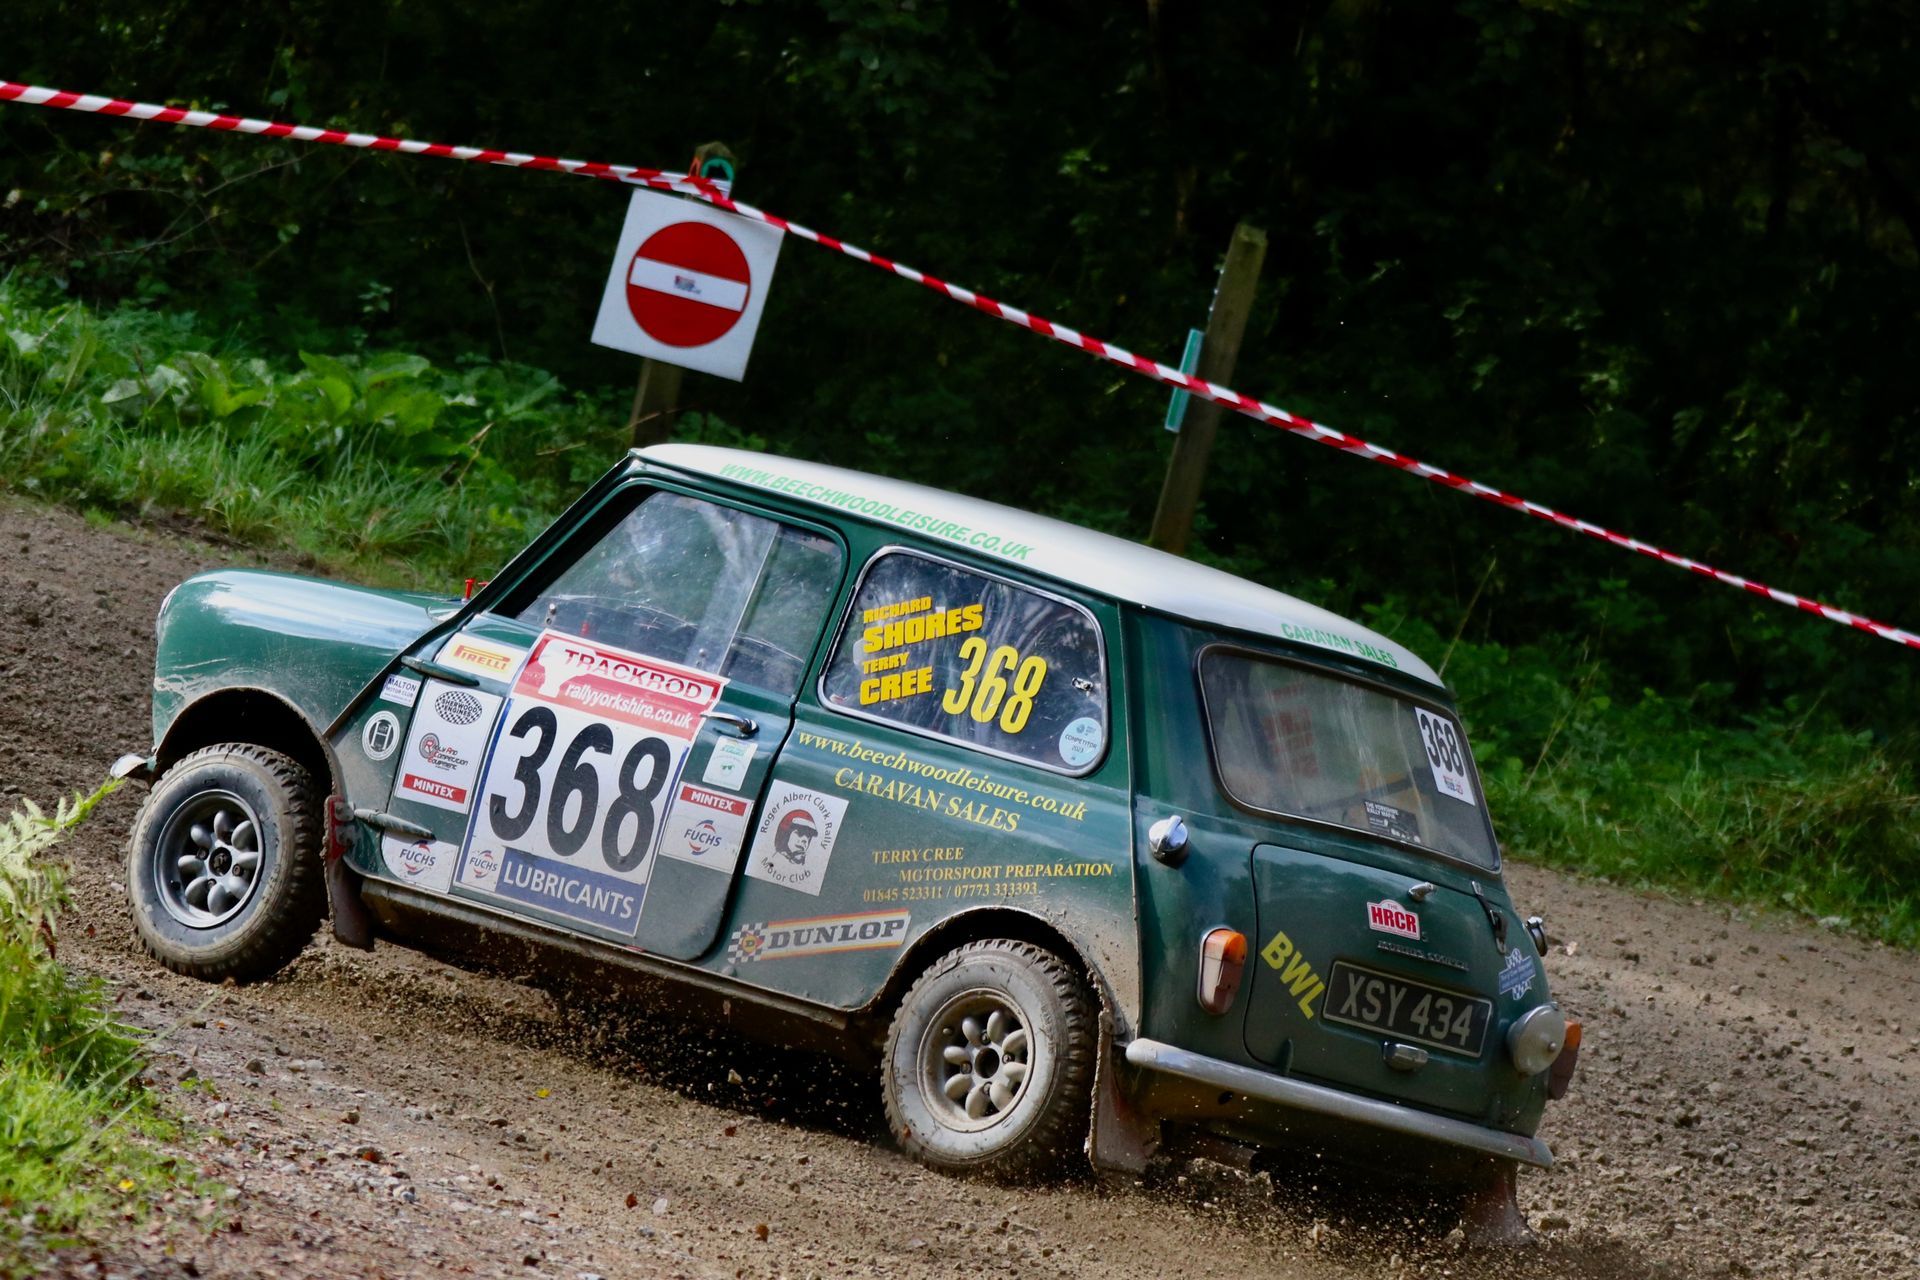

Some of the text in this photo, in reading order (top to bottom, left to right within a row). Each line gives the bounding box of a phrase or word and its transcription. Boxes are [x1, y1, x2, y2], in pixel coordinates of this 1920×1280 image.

[720, 463, 1035, 561] WWW.BEECHWOODLEISURE.CO.UK
[863, 596, 932, 623] RICHARD
[862, 603, 984, 653] SHORES
[454, 644, 511, 670] PIRELLI
[1281, 623, 1398, 668] CARAVAN SALES
[564, 649, 702, 699] TRACKROD
[862, 652, 909, 674] TERRY
[387, 677, 417, 691] MALTON
[859, 666, 933, 705] CREE
[943, 637, 1047, 734] 368
[442, 699, 478, 713] SHERWOOD
[565, 682, 693, 729] rallyyorkshire.co.uk
[1421, 713, 1464, 777] 368
[413, 778, 454, 799] MINTEX
[489, 706, 672, 873] 368
[798, 731, 1089, 822] www.beechwoodleisure.co.uk
[691, 791, 735, 811] MINTEX
[834, 767, 1021, 833] CARAVAN SALES
[760, 792, 832, 850] Roger Albert Clark Rally
[683, 829, 722, 848] FUCHS
[399, 848, 436, 867] FUCHS
[469, 857, 498, 872] FUCHS
[761, 857, 811, 883] Motor Club
[872, 847, 964, 864] TERRY CREE
[899, 863, 1114, 883] MOTORSPORT PREPARATION
[503, 861, 634, 920] LUBRICANTS
[863, 888, 899, 902] 01845
[954, 883, 991, 898] 07773
[767, 919, 904, 950] DUNLOP
[1370, 906, 1417, 933] HRCR
[1260, 930, 1326, 1020] BWL
[1339, 969, 1473, 1046] XSY 434
